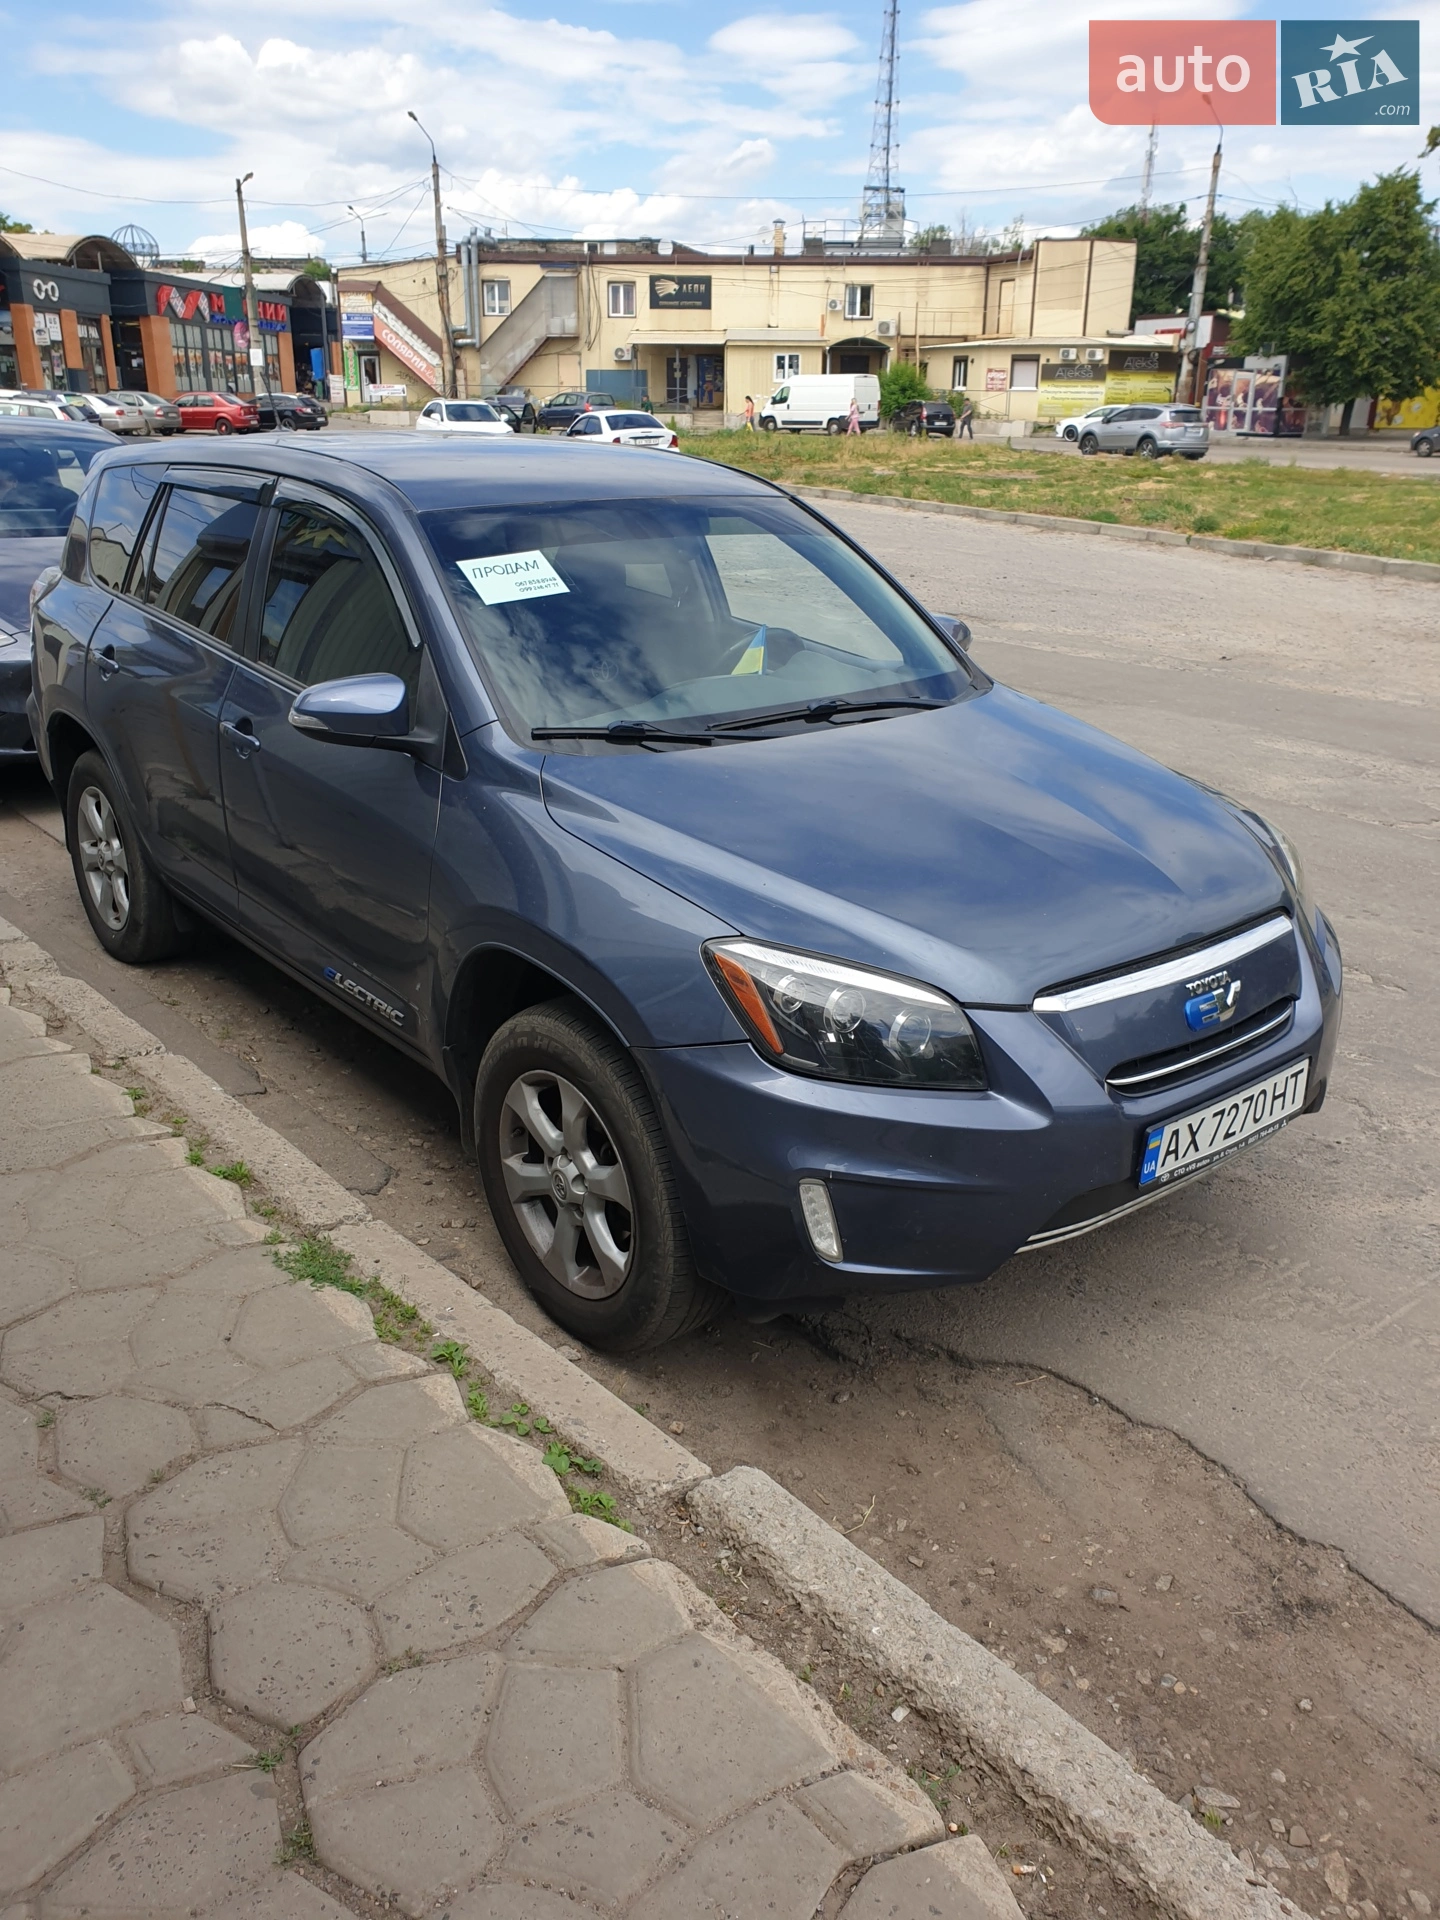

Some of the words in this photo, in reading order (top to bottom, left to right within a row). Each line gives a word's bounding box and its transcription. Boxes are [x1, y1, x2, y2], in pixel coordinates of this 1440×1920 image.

[472, 560, 540, 579] ПРОДАМ
[323, 966, 405, 1027] ELECTRIC
[1185, 970, 1231, 997] TOYOTA
[1184, 980, 1241, 1032] EV
[1160, 1117, 1206, 1168] AX
[1208, 1088, 1267, 1147] 7270
[1269, 1067, 1304, 1117] HT
[1144, 1160, 1156, 1174] UA
